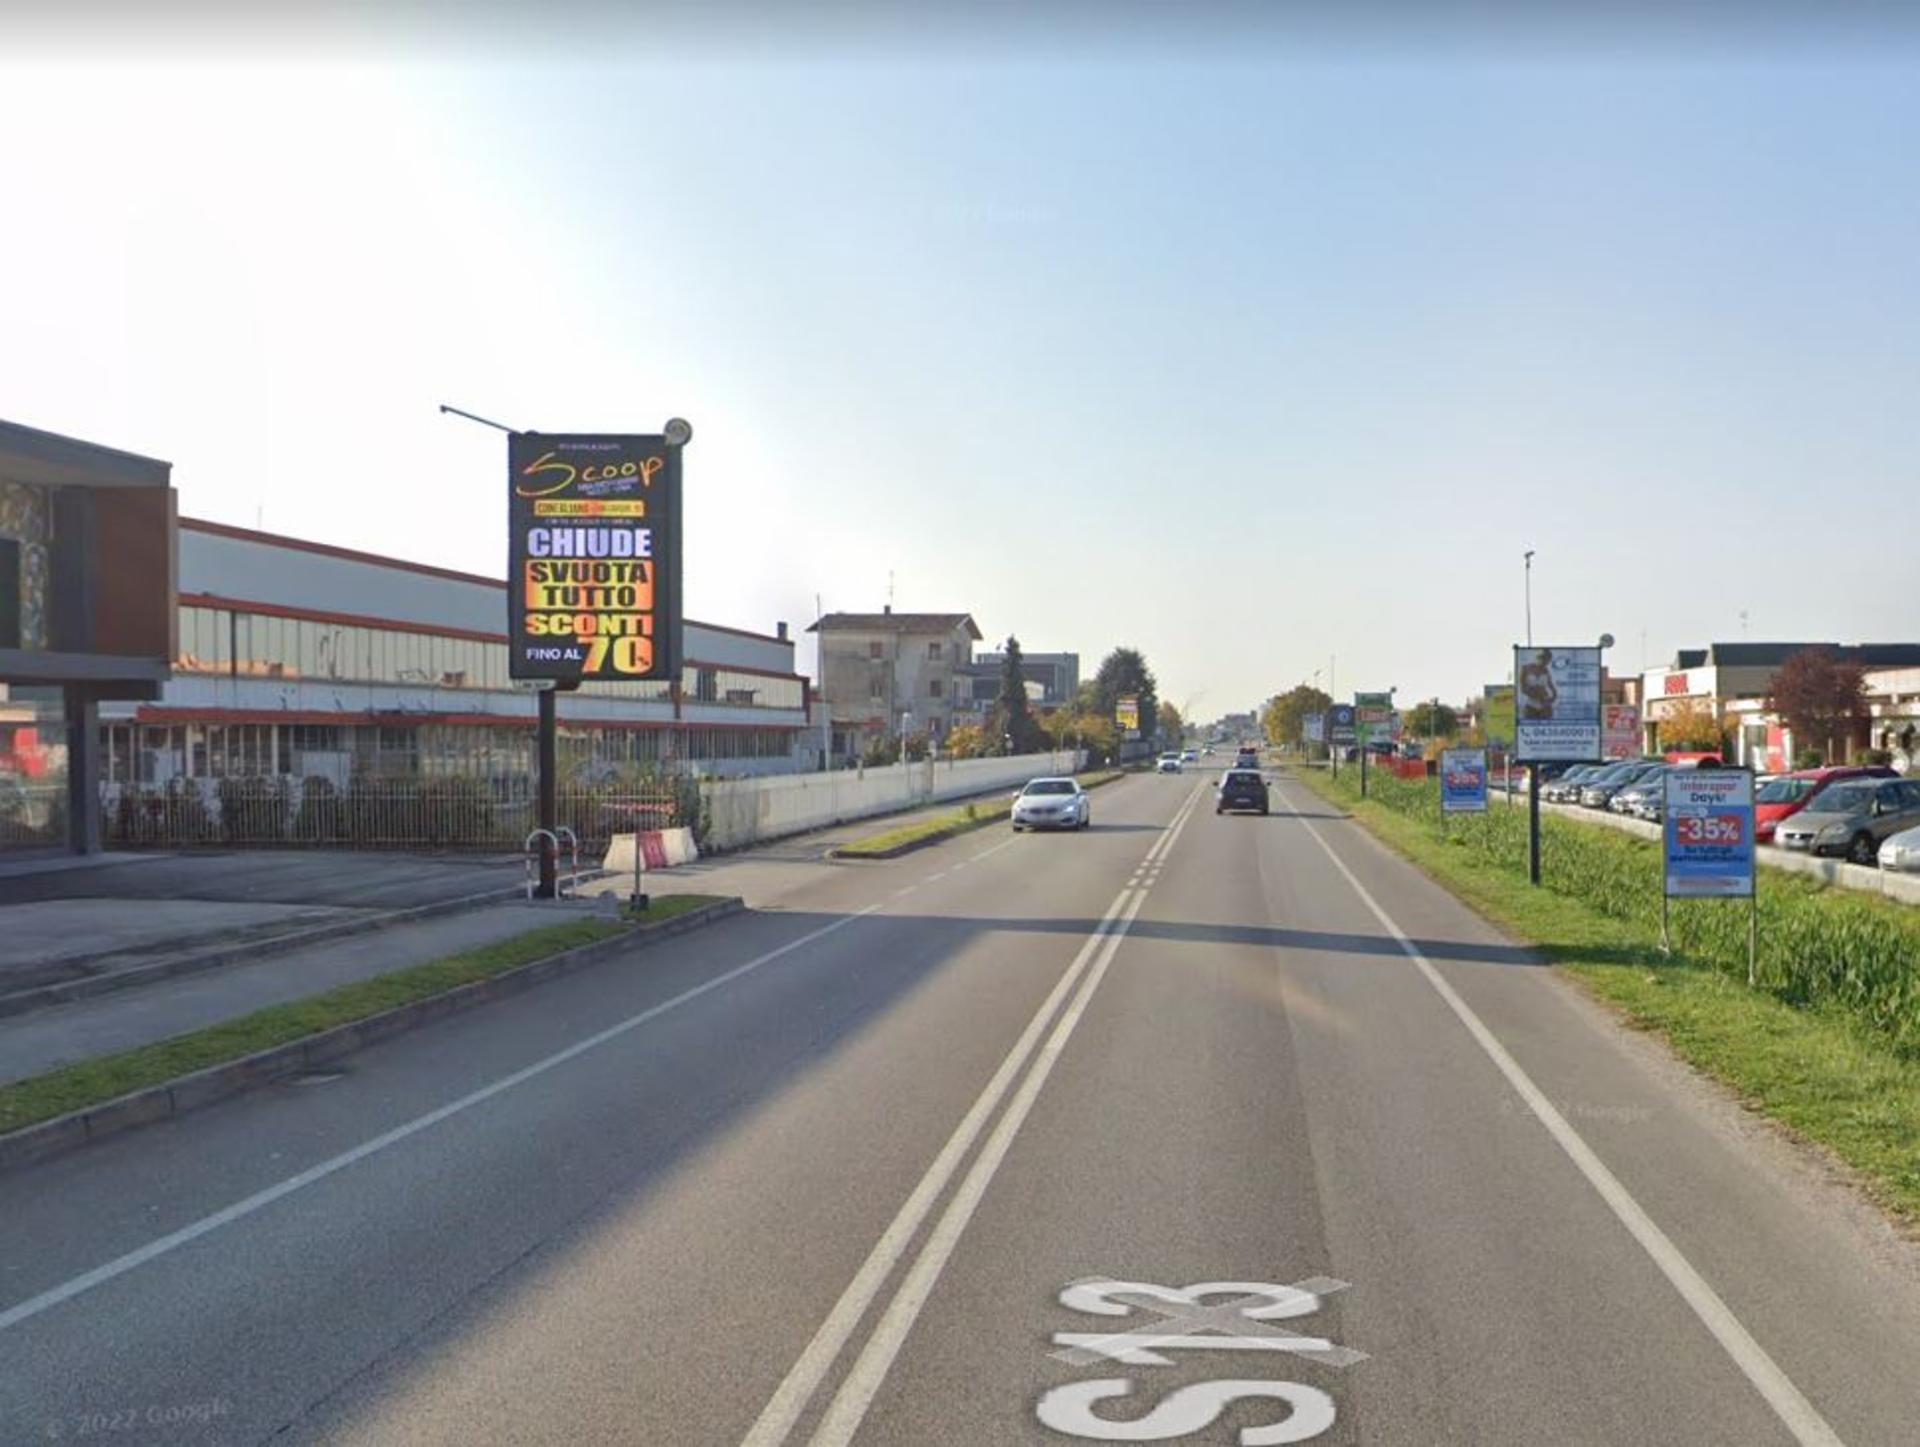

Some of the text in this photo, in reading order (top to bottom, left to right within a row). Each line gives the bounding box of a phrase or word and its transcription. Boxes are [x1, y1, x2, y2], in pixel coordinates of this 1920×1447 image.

[516, 452, 664, 496] Scoop
[528, 528, 652, 557] CHIUDE
[529, 562, 648, 583] SVUOTA
[542, 586, 636, 606] TUTTO
[525, 613, 653, 635] SCONTI
[526, 648, 582, 660] FINO AL
[1677, 818, 1740, 840] -35%
